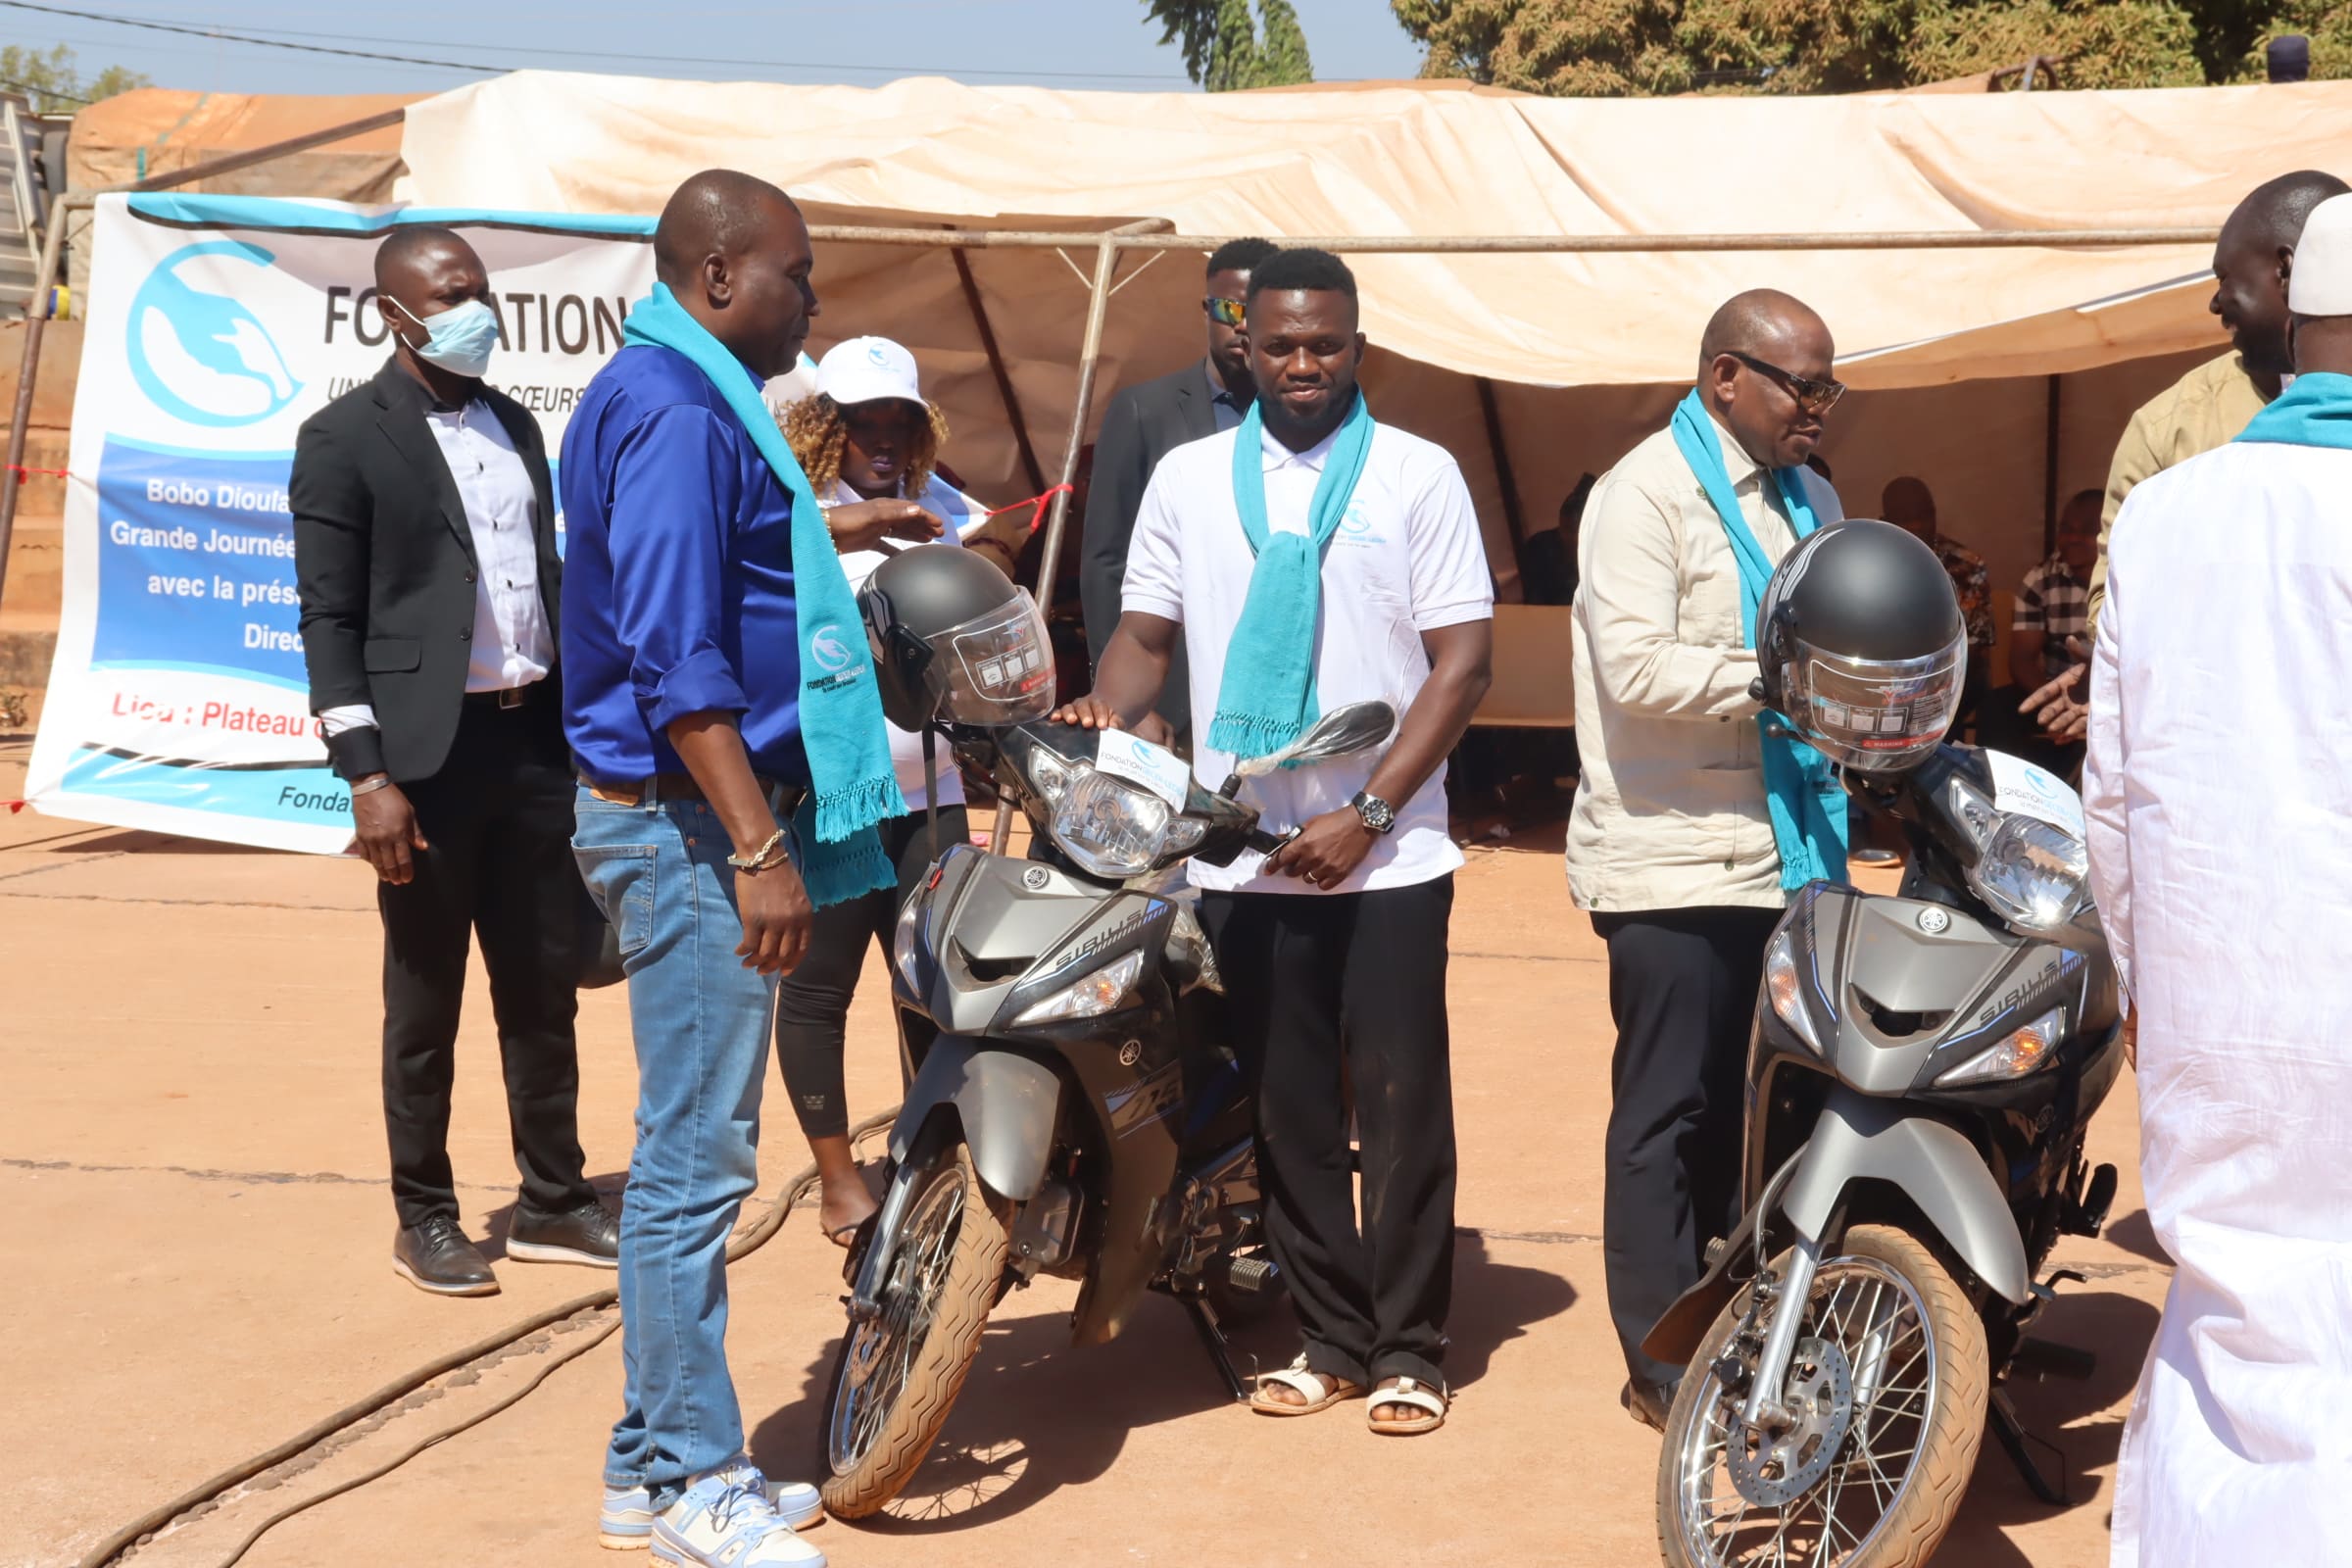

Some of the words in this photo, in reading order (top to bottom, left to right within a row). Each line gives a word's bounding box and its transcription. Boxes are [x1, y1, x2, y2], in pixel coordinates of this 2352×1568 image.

[324, 286, 626, 355] FOATION
[147, 478, 210, 507] Bobo
[111, 521, 198, 551] Grande
[147, 574, 205, 598] avec
[214, 575, 234, 600] la
[242, 580, 302, 607] prés
[202, 702, 304, 737] Plateau
